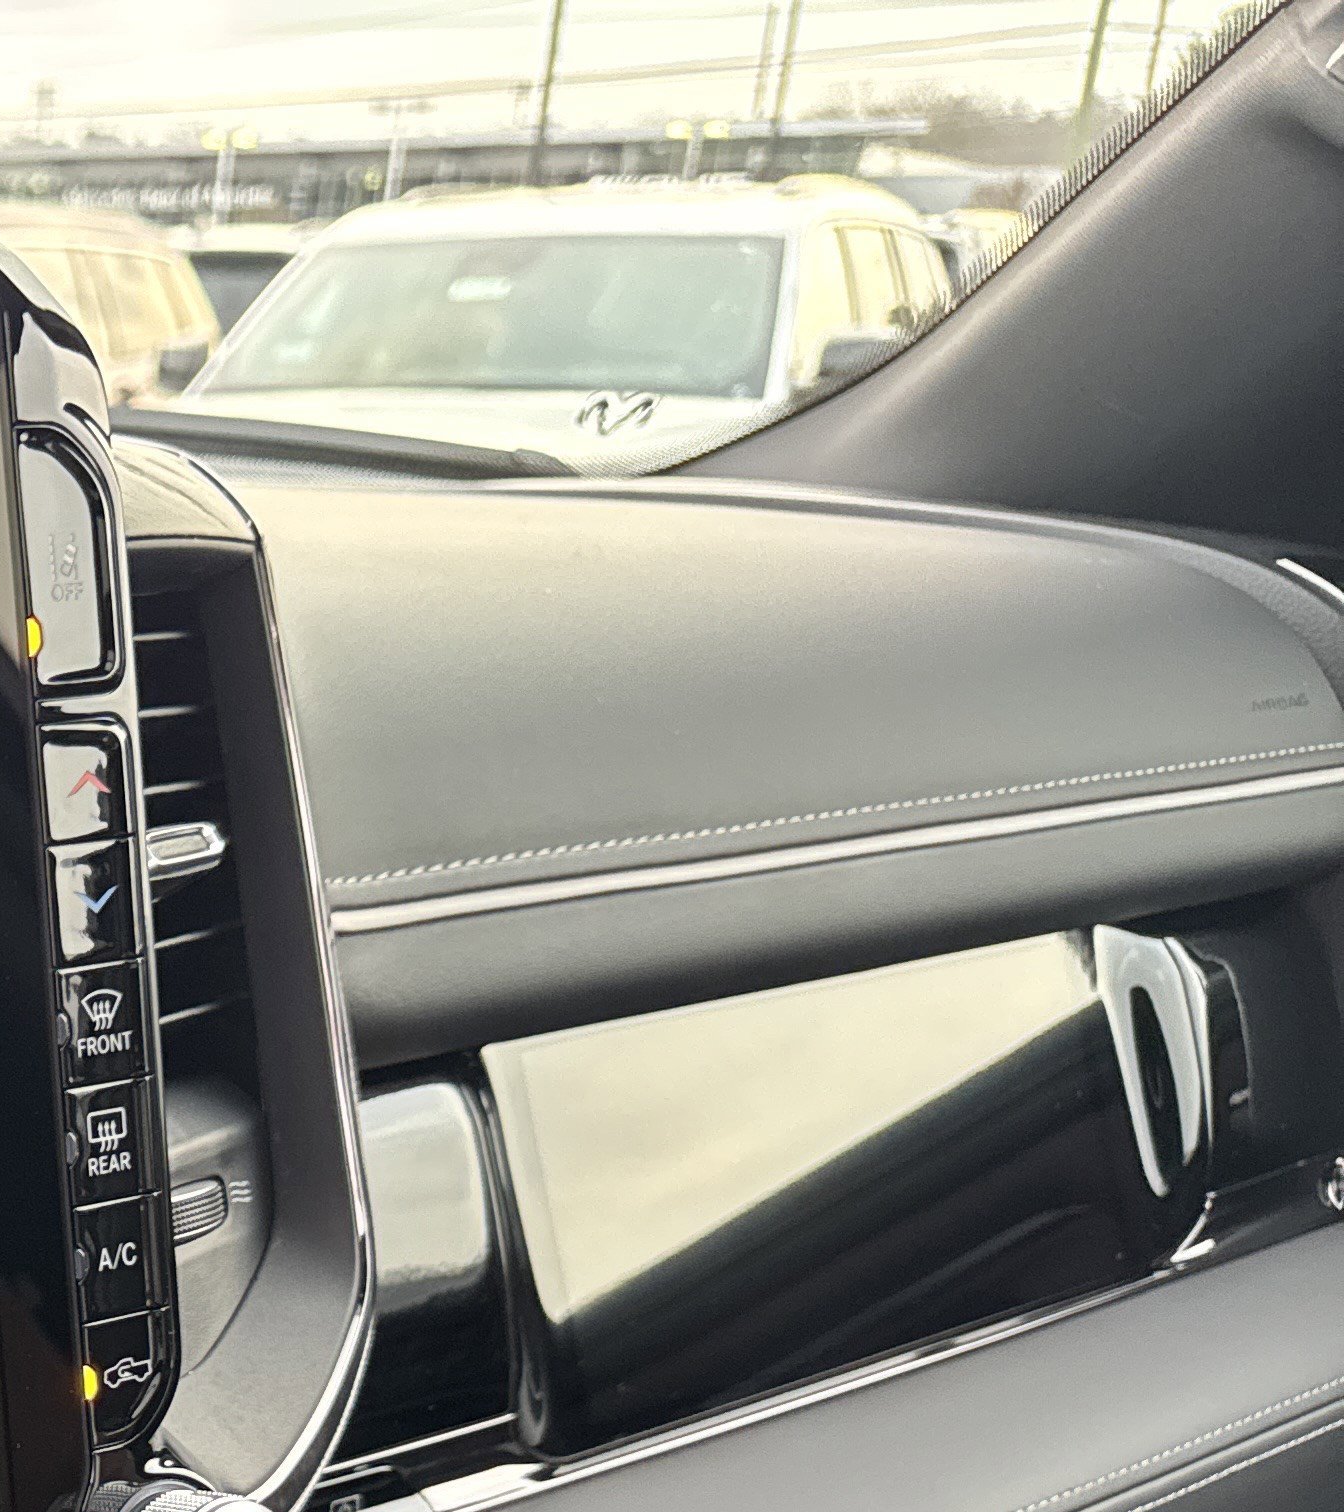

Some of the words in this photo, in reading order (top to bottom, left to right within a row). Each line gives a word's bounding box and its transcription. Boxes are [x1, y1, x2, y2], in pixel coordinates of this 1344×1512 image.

[51, 582, 83, 602] OFF
[76, 1029, 133, 1059] FRONT
[87, 1151, 132, 1177] REAR
[98, 1241, 138, 1273] A/C
